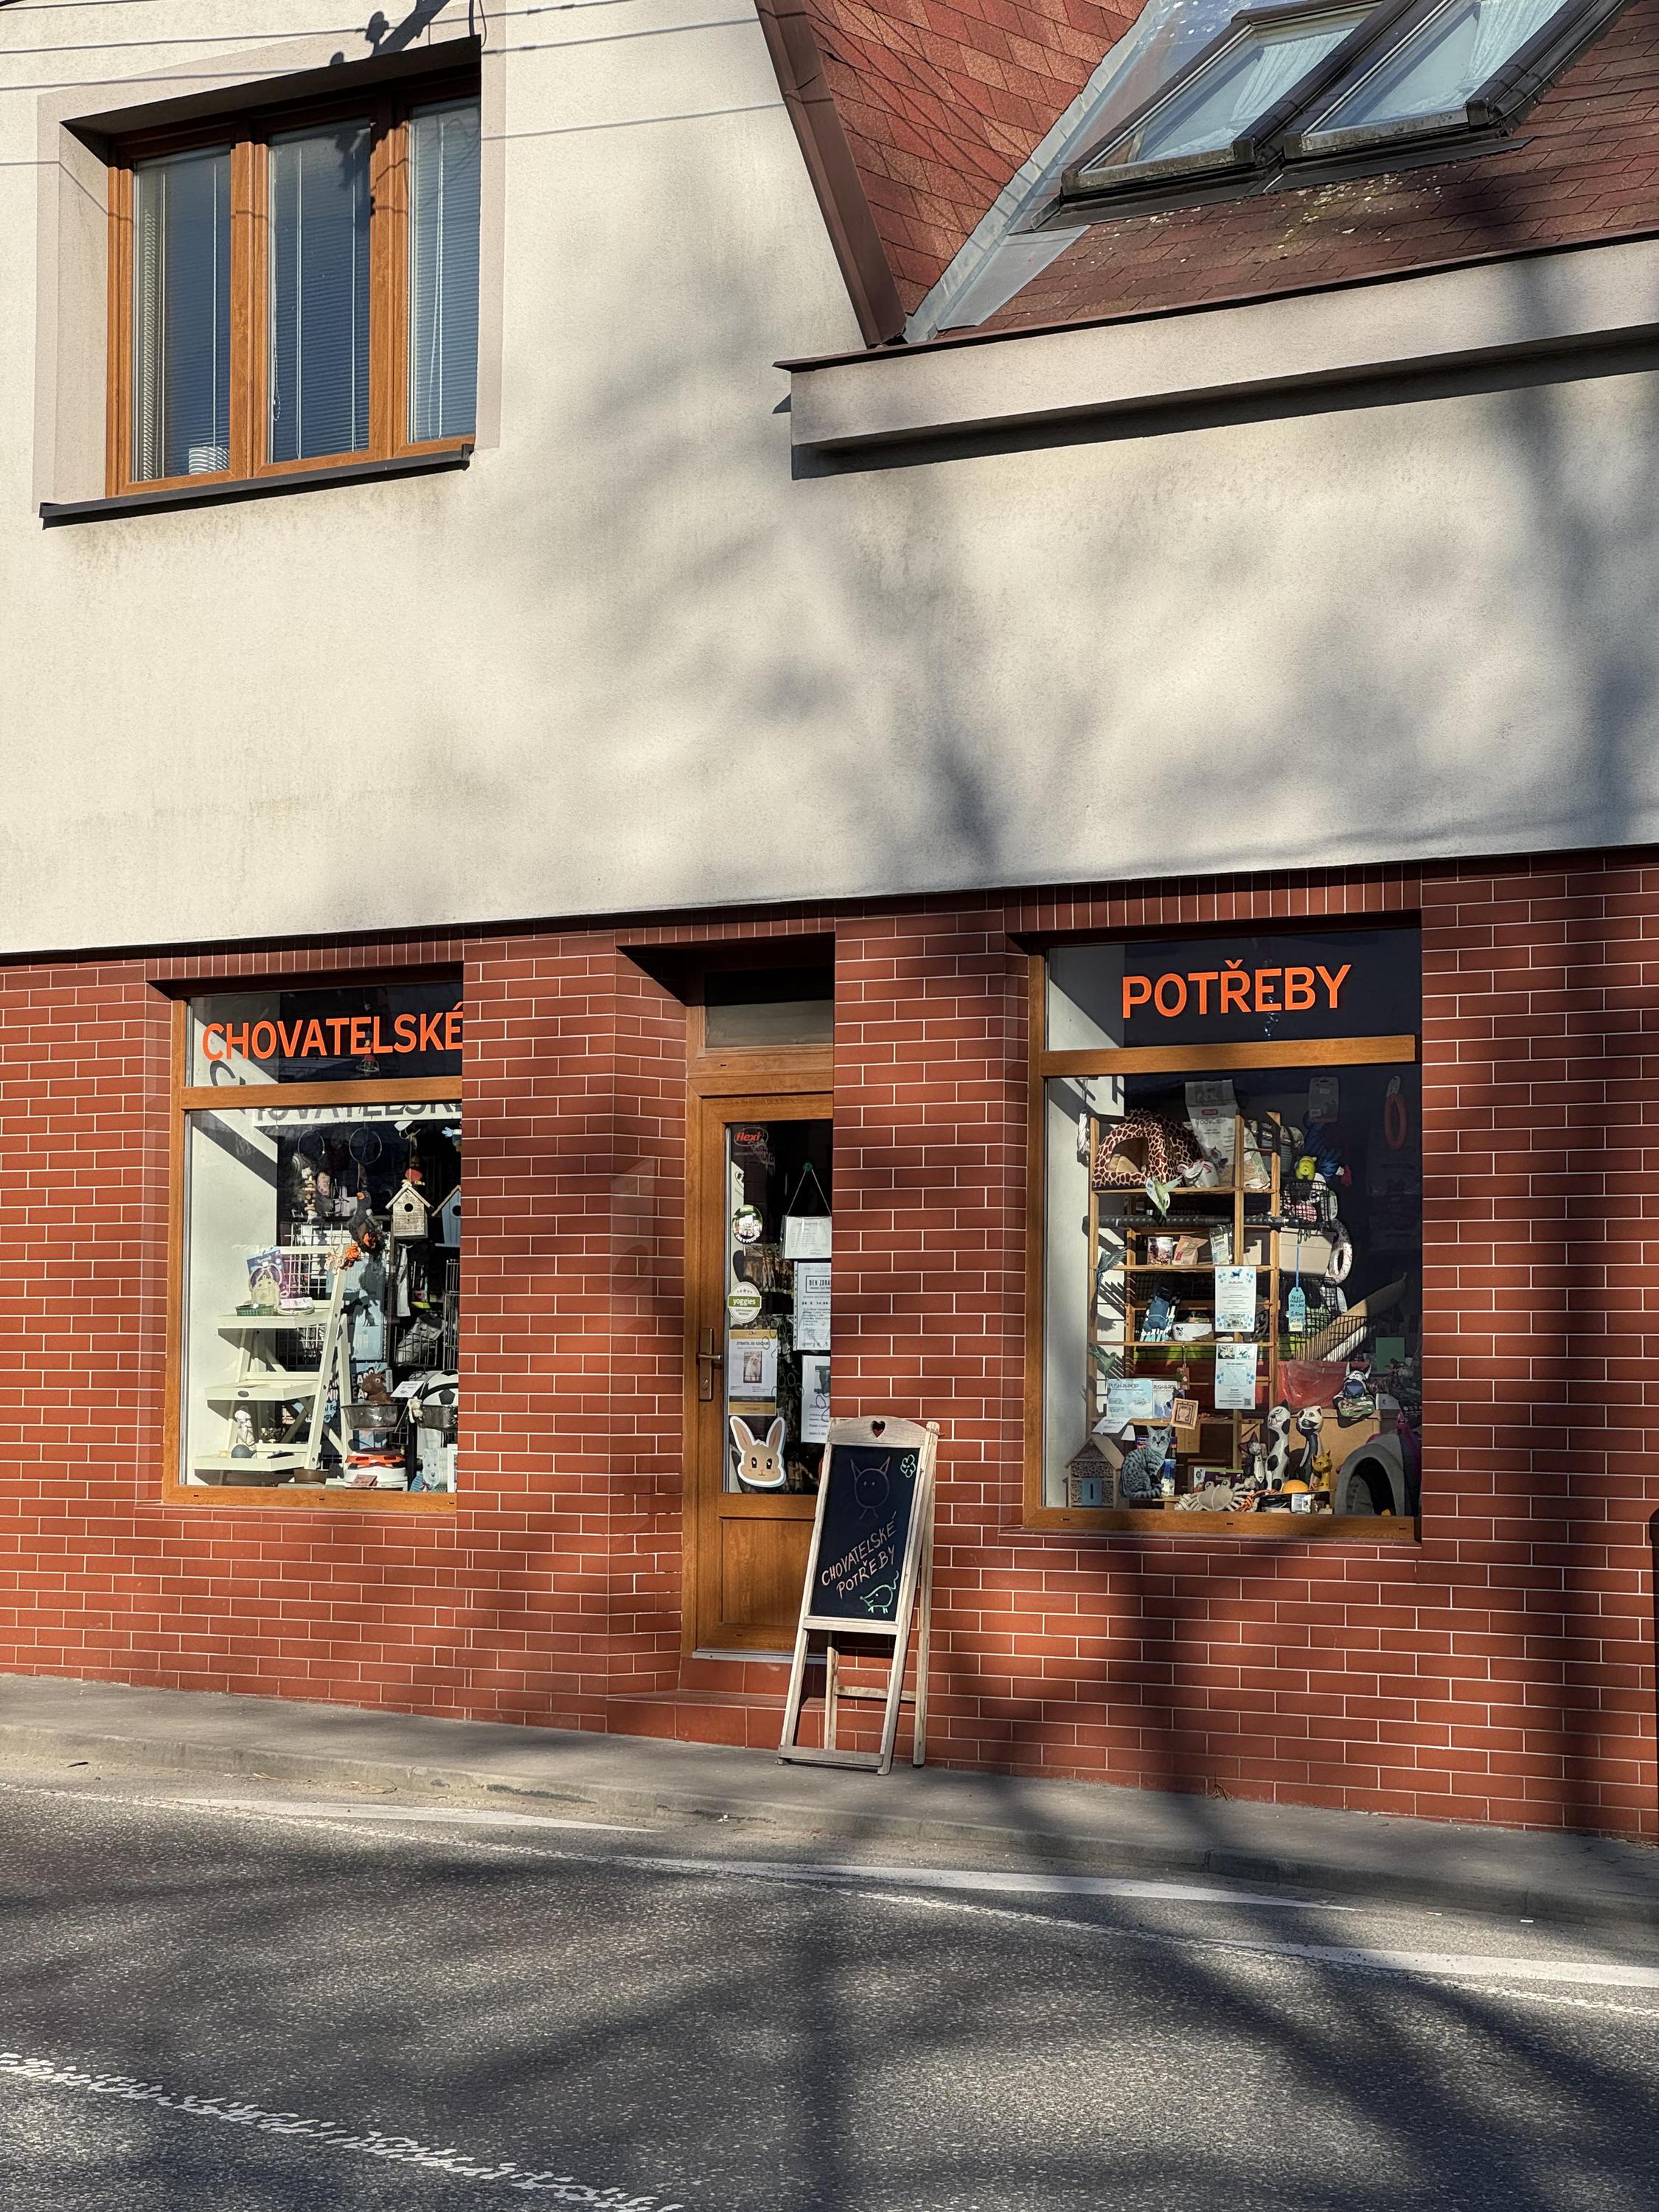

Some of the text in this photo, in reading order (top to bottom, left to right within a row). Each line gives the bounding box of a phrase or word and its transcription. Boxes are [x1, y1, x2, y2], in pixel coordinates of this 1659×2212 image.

[1122, 959, 1352, 1018] POTŘEBY
[204, 1002, 463, 1060] CHOVATELSKÉ
[733, 1298, 756, 1306] yoggies
[821, 1510, 897, 1586] CHOVATELSKÉ
[836, 1545, 895, 1599] POTŘEBY
